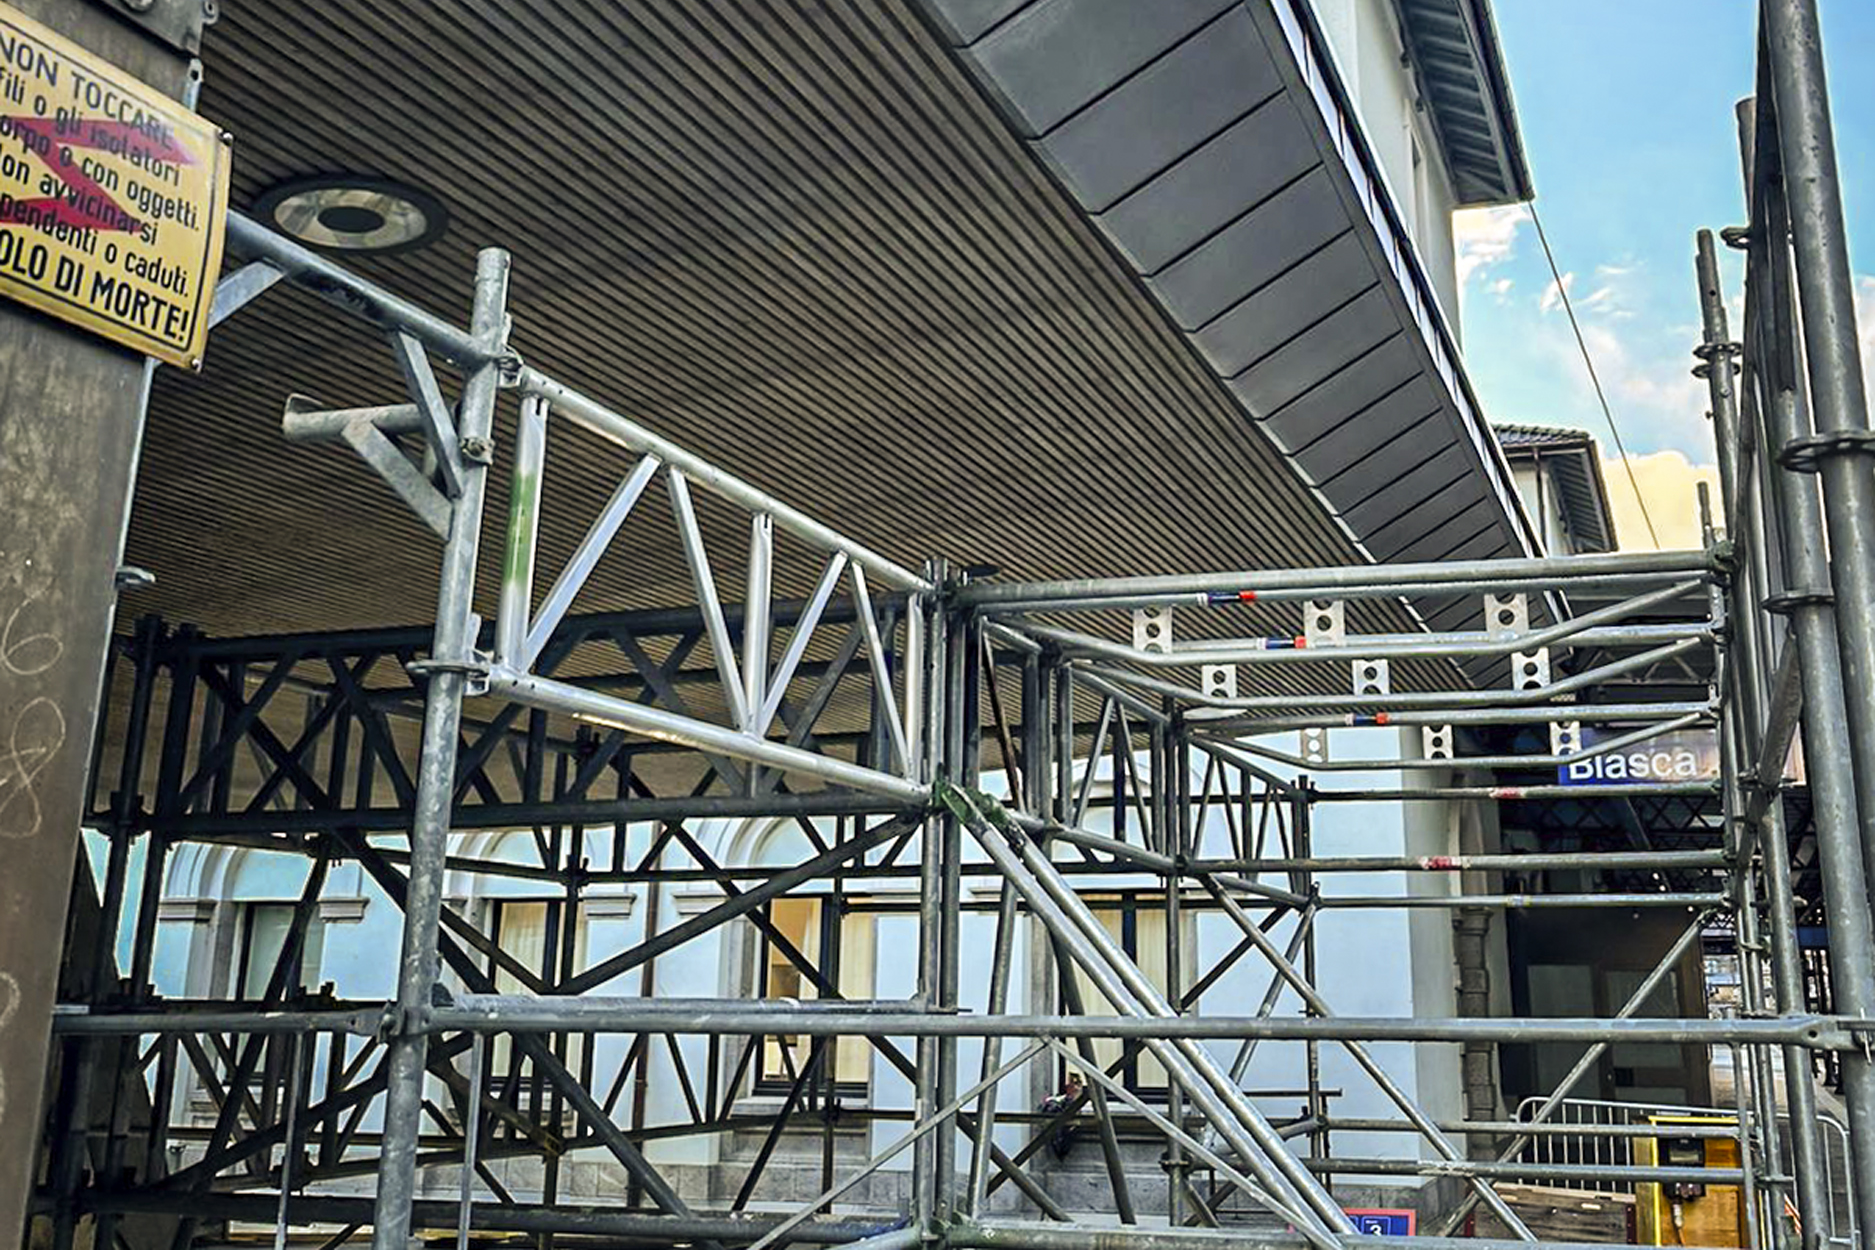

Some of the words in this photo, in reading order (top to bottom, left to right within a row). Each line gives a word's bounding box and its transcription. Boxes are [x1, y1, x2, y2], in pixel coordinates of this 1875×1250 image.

[0, 35, 58, 87] NON
[71, 70, 174, 151] TOCCARE
[34, 95, 47, 116] o
[55, 105, 84, 136] gli
[90, 125, 181, 187] isolatori
[0, 143, 30, 185] on
[40, 173, 158, 245] avvicinarsi
[60, 146, 74, 168] o
[82, 157, 119, 192] con
[127, 180, 200, 232] oggetti.
[54, 255, 84, 297] DI
[90, 271, 189, 342] MORTE!
[105, 243, 118, 265] o
[125, 252, 189, 298] caduti.
